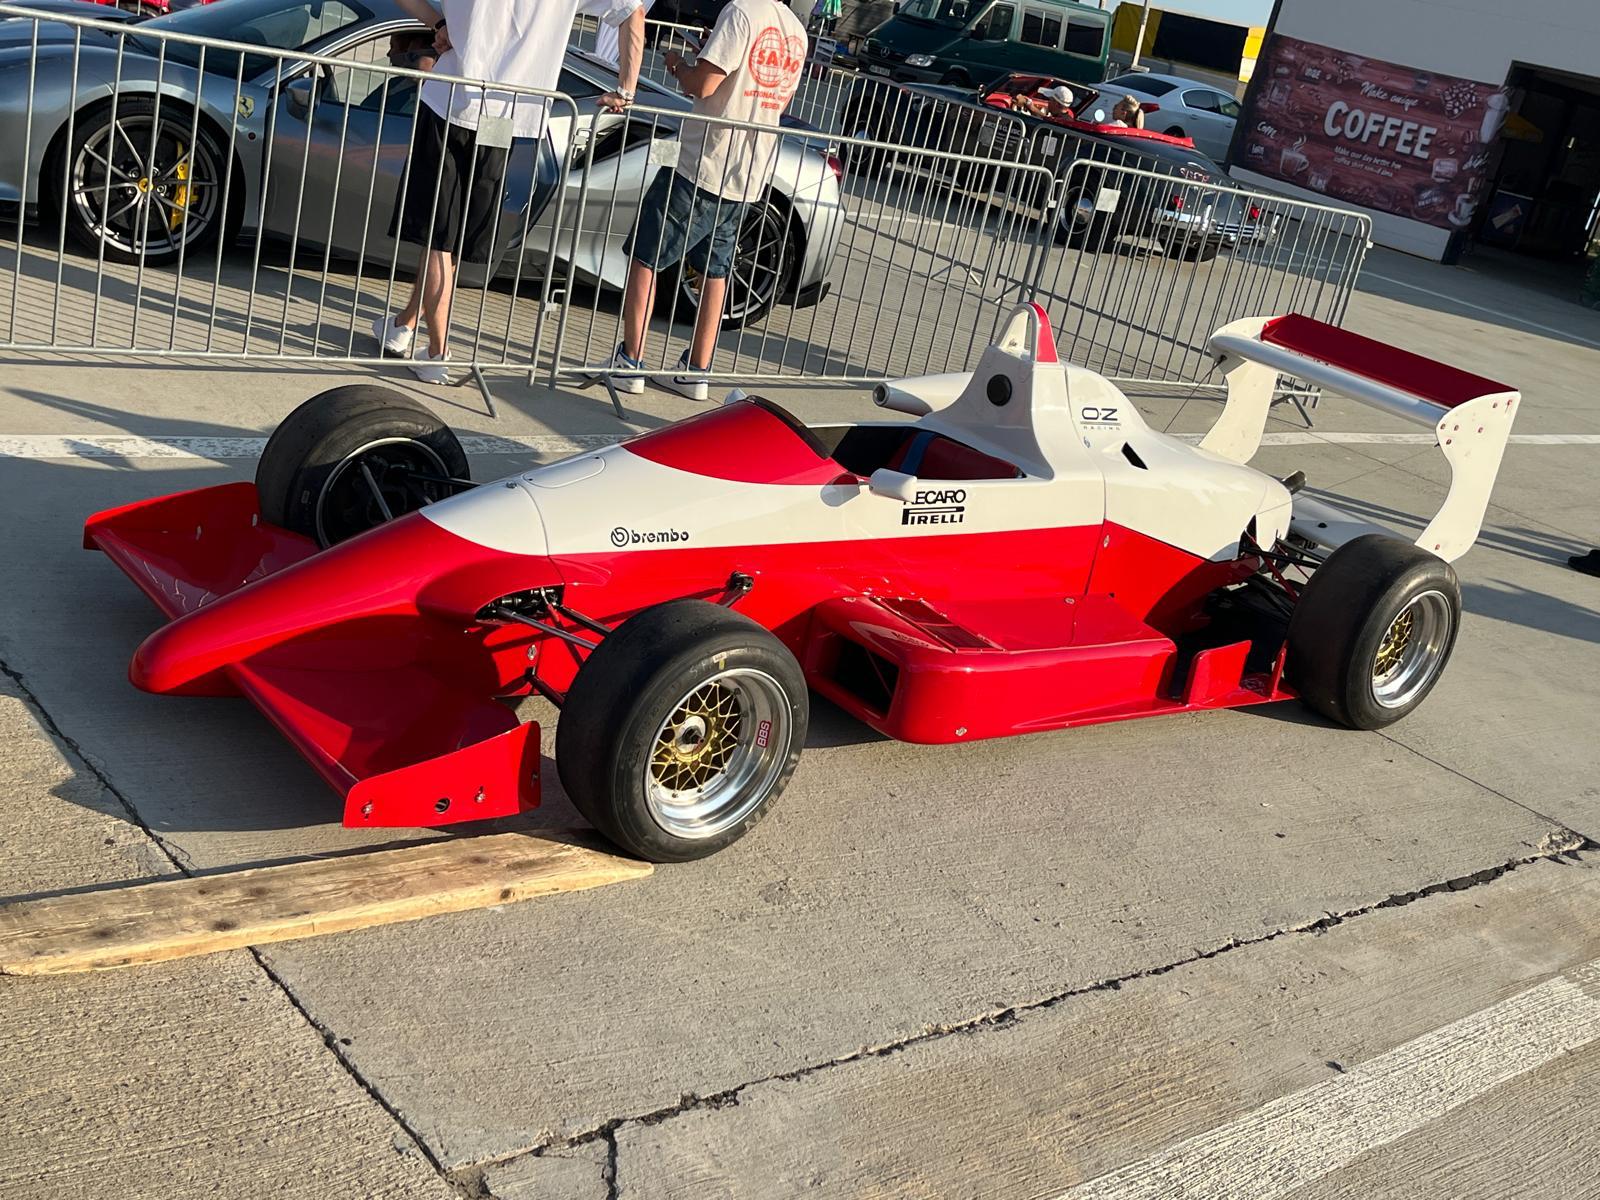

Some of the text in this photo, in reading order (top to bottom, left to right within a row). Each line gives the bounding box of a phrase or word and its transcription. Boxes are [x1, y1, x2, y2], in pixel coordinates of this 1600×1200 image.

[743, 90, 776, 100] NATIONAL
[1323, 100, 1438, 160] COFFEE
[903, 489, 967, 506] ECARO
[901, 506, 965, 526] PIRELLI
[631, 528, 690, 544] brembo
[757, 721, 770, 747] BBS
